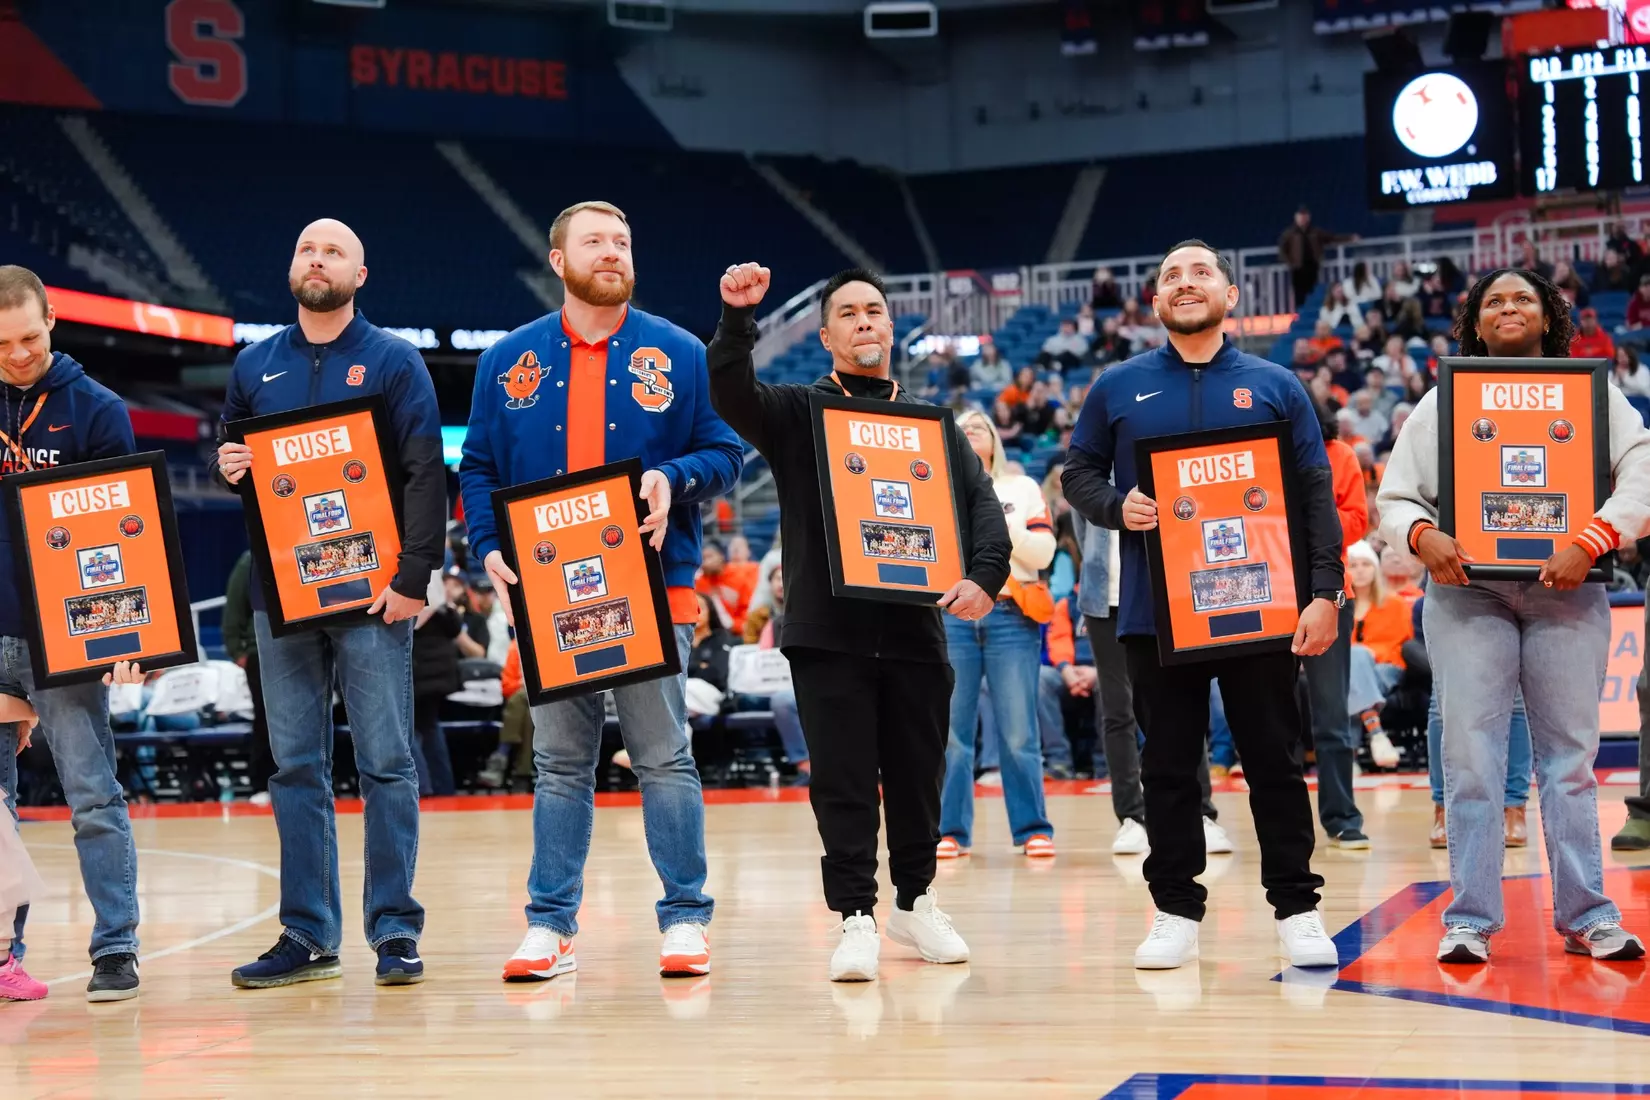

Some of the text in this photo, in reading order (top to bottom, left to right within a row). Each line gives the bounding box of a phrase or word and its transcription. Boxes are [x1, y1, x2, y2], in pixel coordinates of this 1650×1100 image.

[166, 0, 247, 107] S
[350, 45, 568, 100] SYRACUSE
[346, 365, 366, 386] S
[1233, 388, 1253, 408] S
[1485, 384, 1557, 410] 'CUSE
[275, 429, 345, 462] 'CUSE
[851, 422, 914, 450] 'CUSE
[0, 447, 60, 473] ACUSE
[1180, 453, 1248, 485] 'CUSE
[52, 484, 123, 515] 'CUSE
[538, 493, 604, 529] 'CUSE
